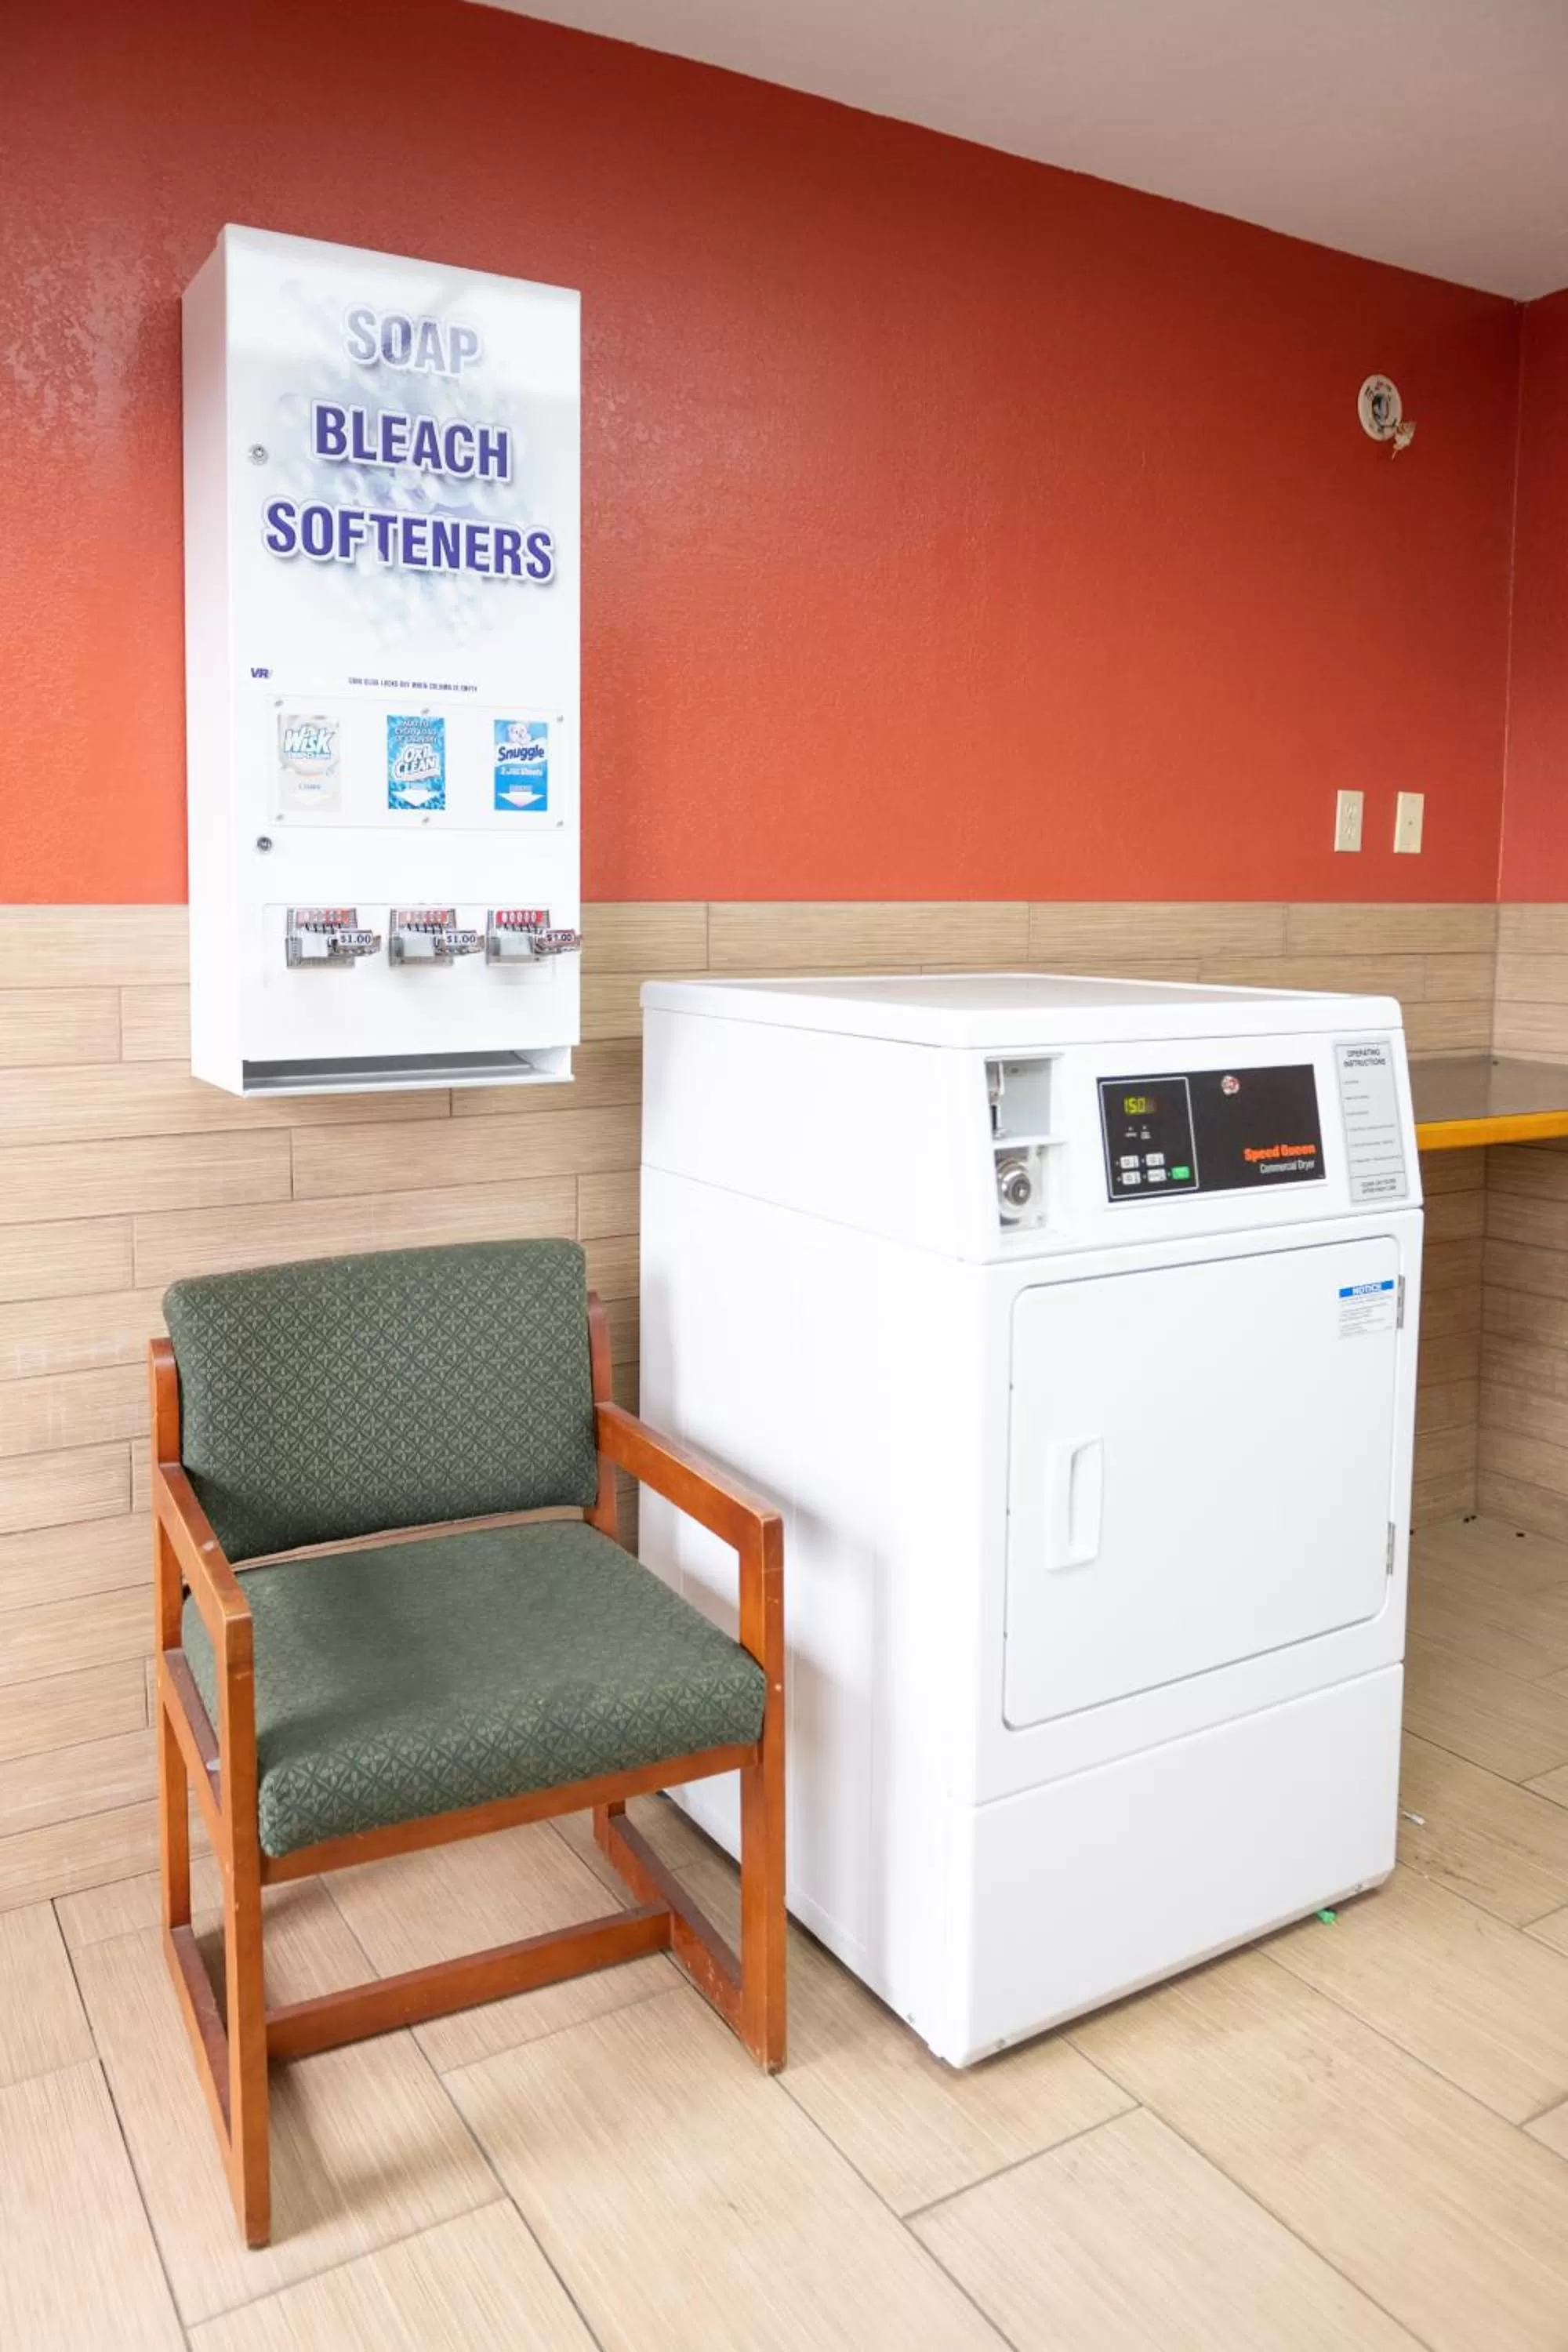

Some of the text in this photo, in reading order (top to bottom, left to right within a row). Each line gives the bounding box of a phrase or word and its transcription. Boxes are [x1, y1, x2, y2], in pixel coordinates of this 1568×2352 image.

[347, 310, 478, 374] SOAP
[315, 404, 508, 478] BLEACH
[266, 501, 551, 580] SOFTENERS
[404, 746, 430, 763] OXI
[498, 744, 545, 762] Snuggle
[395, 755, 437, 778] CLEAN
[340, 934, 371, 944] $1.00
[446, 934, 476, 944] $1.00
